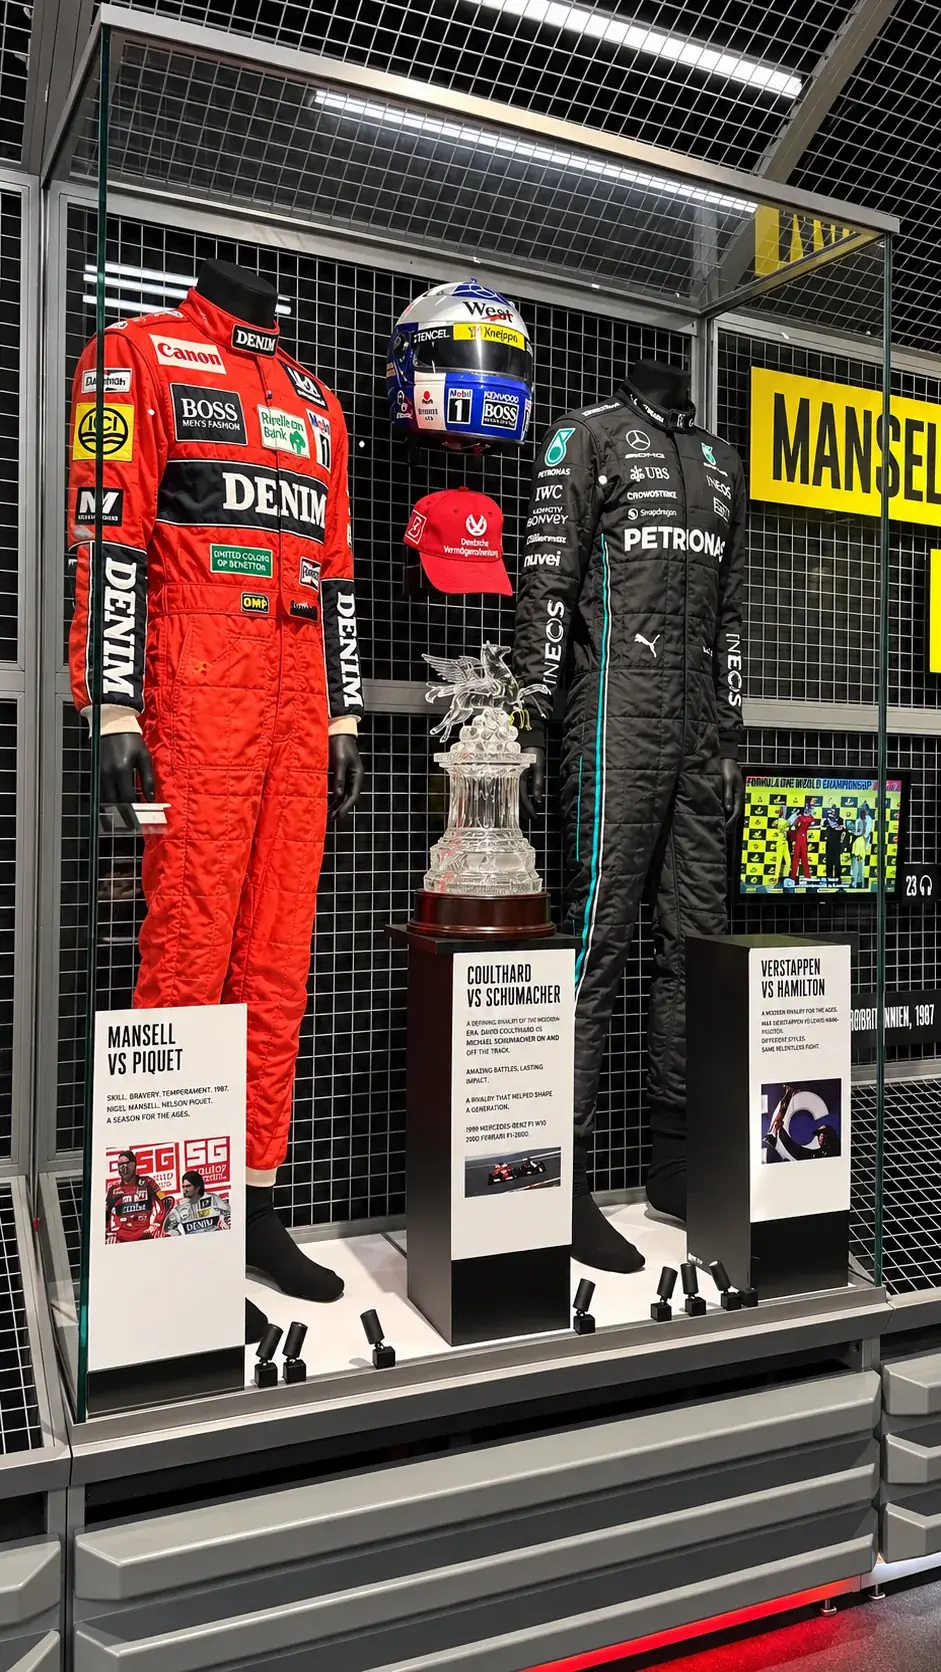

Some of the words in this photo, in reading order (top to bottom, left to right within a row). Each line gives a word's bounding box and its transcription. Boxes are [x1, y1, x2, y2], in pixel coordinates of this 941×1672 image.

[463, 301, 513, 322] West
[236, 329, 276, 351] DENIM
[157, 342, 222, 366] Canon
[450, 389, 471, 398] Mobil
[181, 398, 237, 421] BOSS
[455, 400, 462, 421] 1
[484, 403, 517, 421] BOSS
[645, 467, 670, 479] UBS
[221, 472, 327, 531] DENIM
[535, 485, 563, 501] IWC
[524, 551, 561, 567] nuvei
[243, 597, 268, 610] OMP
[102, 557, 137, 698] DENIM
[336, 592, 363, 708] DENIM
[543, 600, 564, 684] INEOS
[725, 633, 743, 707] INEOS
[906, 875, 917, 896] 23
[467, 964, 532, 985] COULTHARD
[761, 958, 821, 977] VERSTAPPEN
[467, 988, 481, 1007] VS
[486, 985, 561, 1007] SCHUMACHER
[761, 981, 774, 998] VS
[777, 979, 825, 998] HAMILTON
[915, 1004, 935, 1026] 1987
[108, 1023, 176, 1048] MANSELL
[108, 1052, 126, 1075] VS
[133, 1049, 183, 1075] PIQUET
[107, 1105, 126, 1113] NIGEL
[161, 1100, 187, 1109] NELSON
[113, 1115, 140, 1124] SEASON
[142, 1113, 156, 1121] FOR
[157, 1112, 170, 1120] THE
